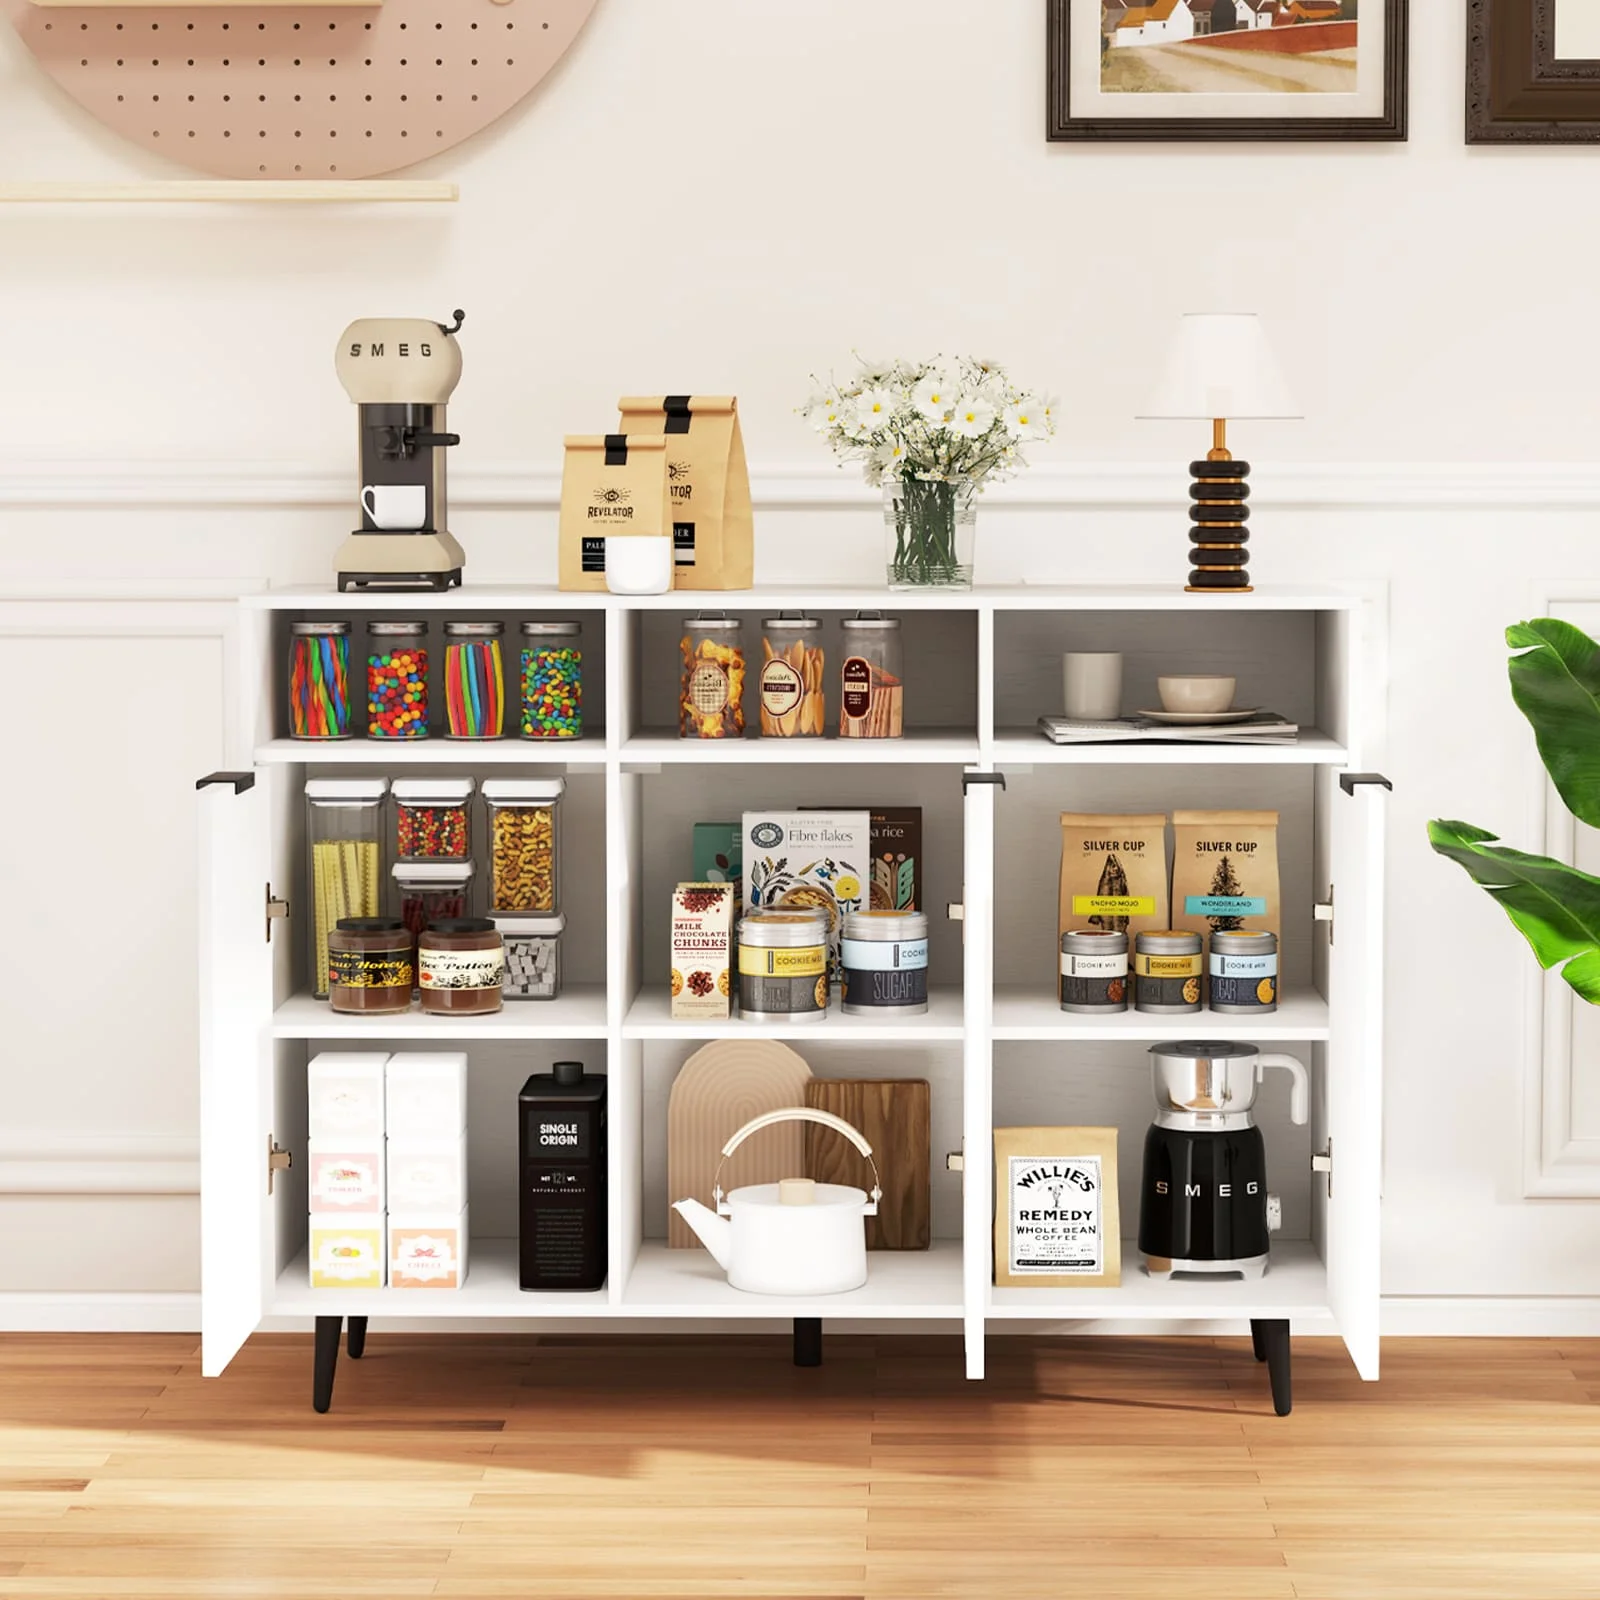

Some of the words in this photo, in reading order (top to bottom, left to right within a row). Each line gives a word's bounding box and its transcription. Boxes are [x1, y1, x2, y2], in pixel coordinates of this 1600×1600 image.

[350, 343, 431, 357] SMEG
[588, 506, 634, 518] REVELATOR
[789, 829, 818, 842] Fibre
[820, 829, 853, 842] flakes
[882, 825, 904, 838] rice
[1083, 841, 1120, 851] SILVER
[1123, 841, 1145, 851] CUP
[1196, 842, 1232, 852] SILVER
[1236, 842, 1258, 852] CUP
[674, 939, 727, 947] CHUNKS
[355, 961, 405, 969] Honey
[776, 956, 811, 965] COOKIE
[873, 972, 914, 1000] SUGAR
[540, 1124, 578, 1134] SINGLE
[540, 1135, 578, 1145] ORIGIN
[1016, 1165, 1095, 1193] WILLIE'S
[1156, 1180, 1258, 1197] SMEG
[1020, 1210, 1093, 1221] REMEDY
[1016, 1225, 1059, 1235] WHOLE
[1063, 1225, 1097, 1234] BEAN
